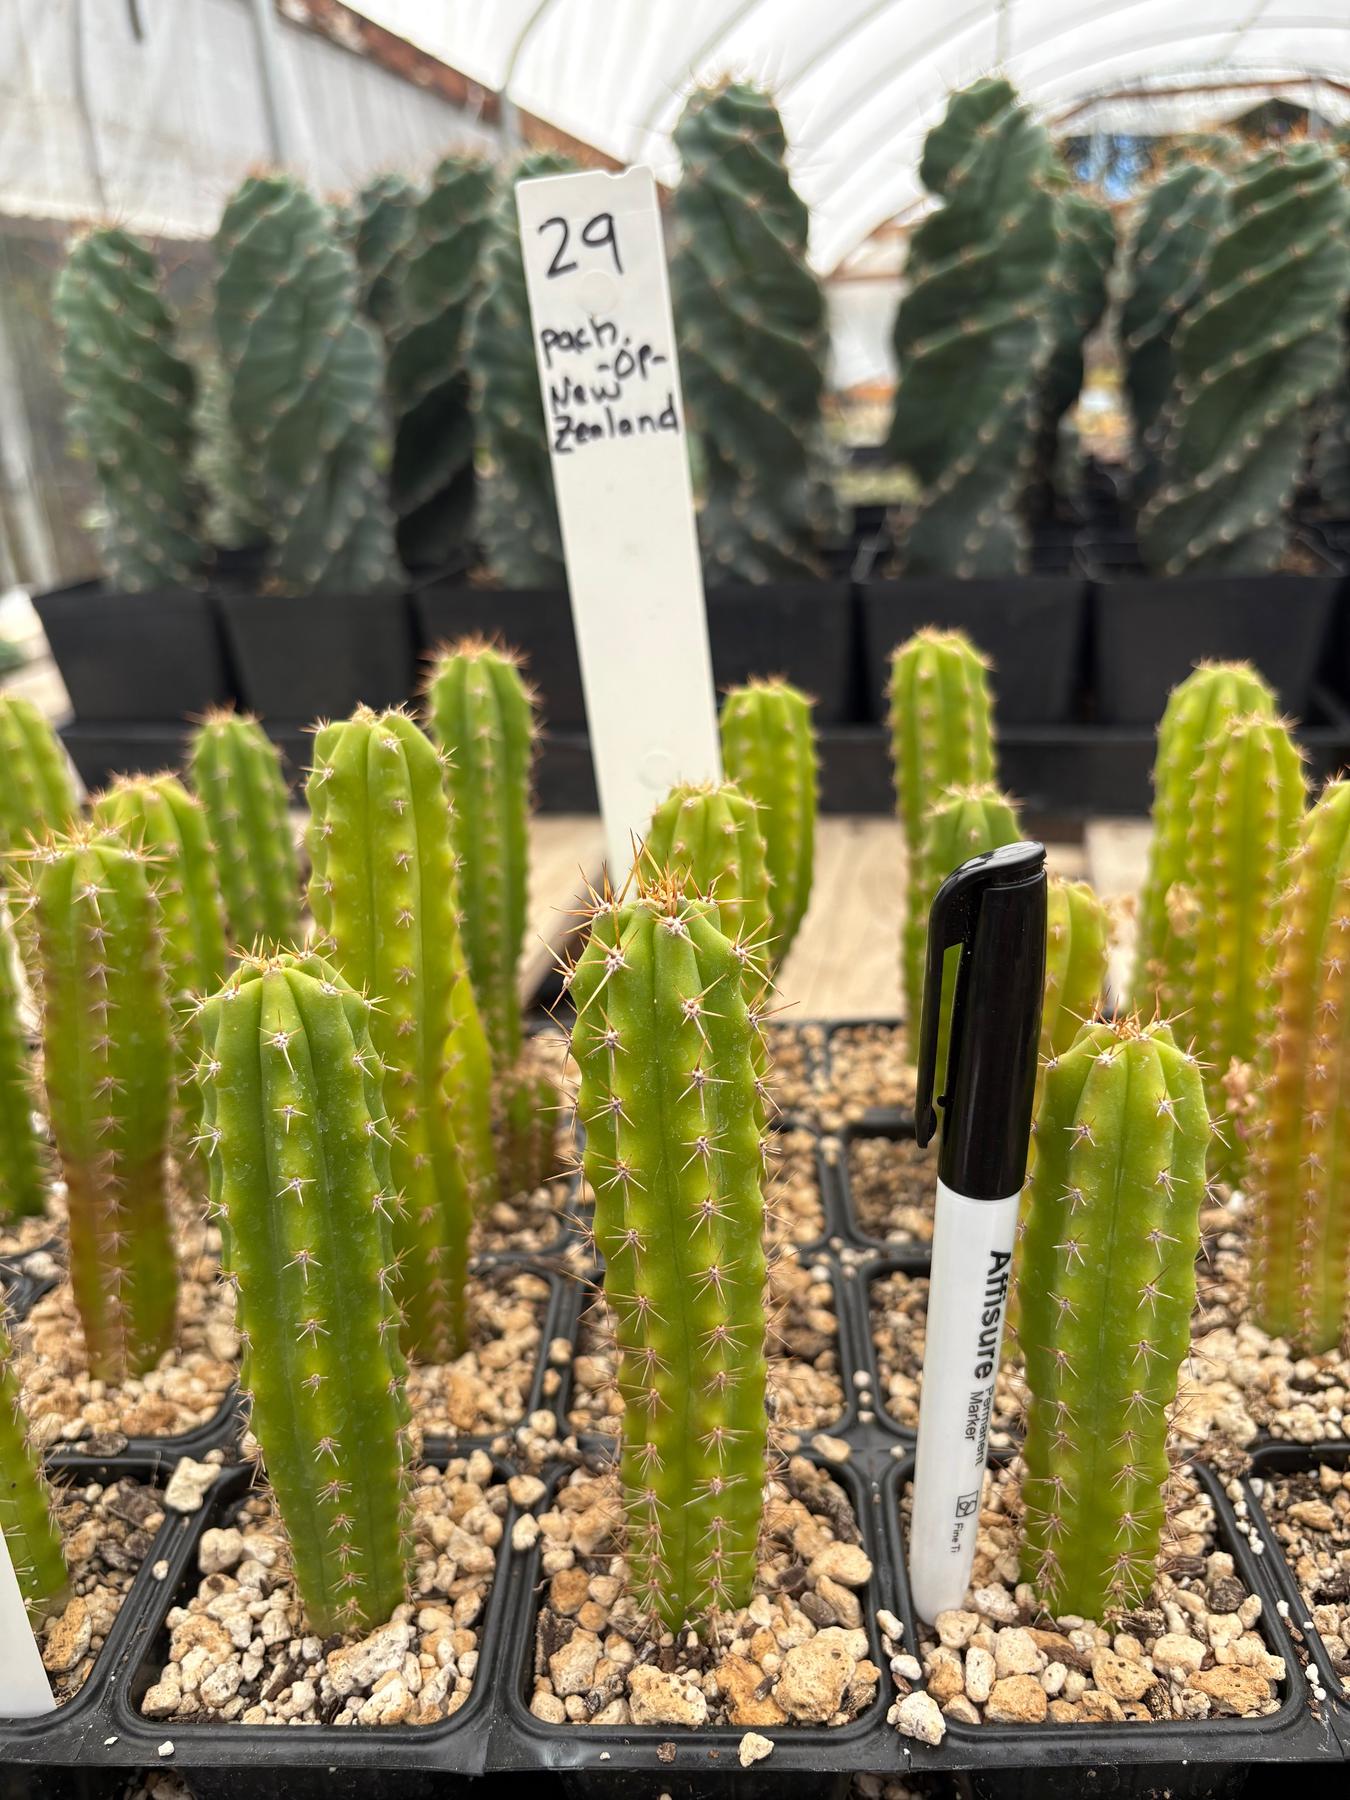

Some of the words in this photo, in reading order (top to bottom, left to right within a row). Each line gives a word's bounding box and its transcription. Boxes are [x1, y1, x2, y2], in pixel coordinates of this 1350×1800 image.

[538, 213, 624, 279] 29
[552, 377, 621, 415] New
[554, 393, 679, 452] Zealand
[974, 1250, 1012, 1380] Affisure
[964, 1391, 984, 1441] Marker
[975, 1384, 995, 1466] Permanent
[952, 1522, 964, 1543] Fine
